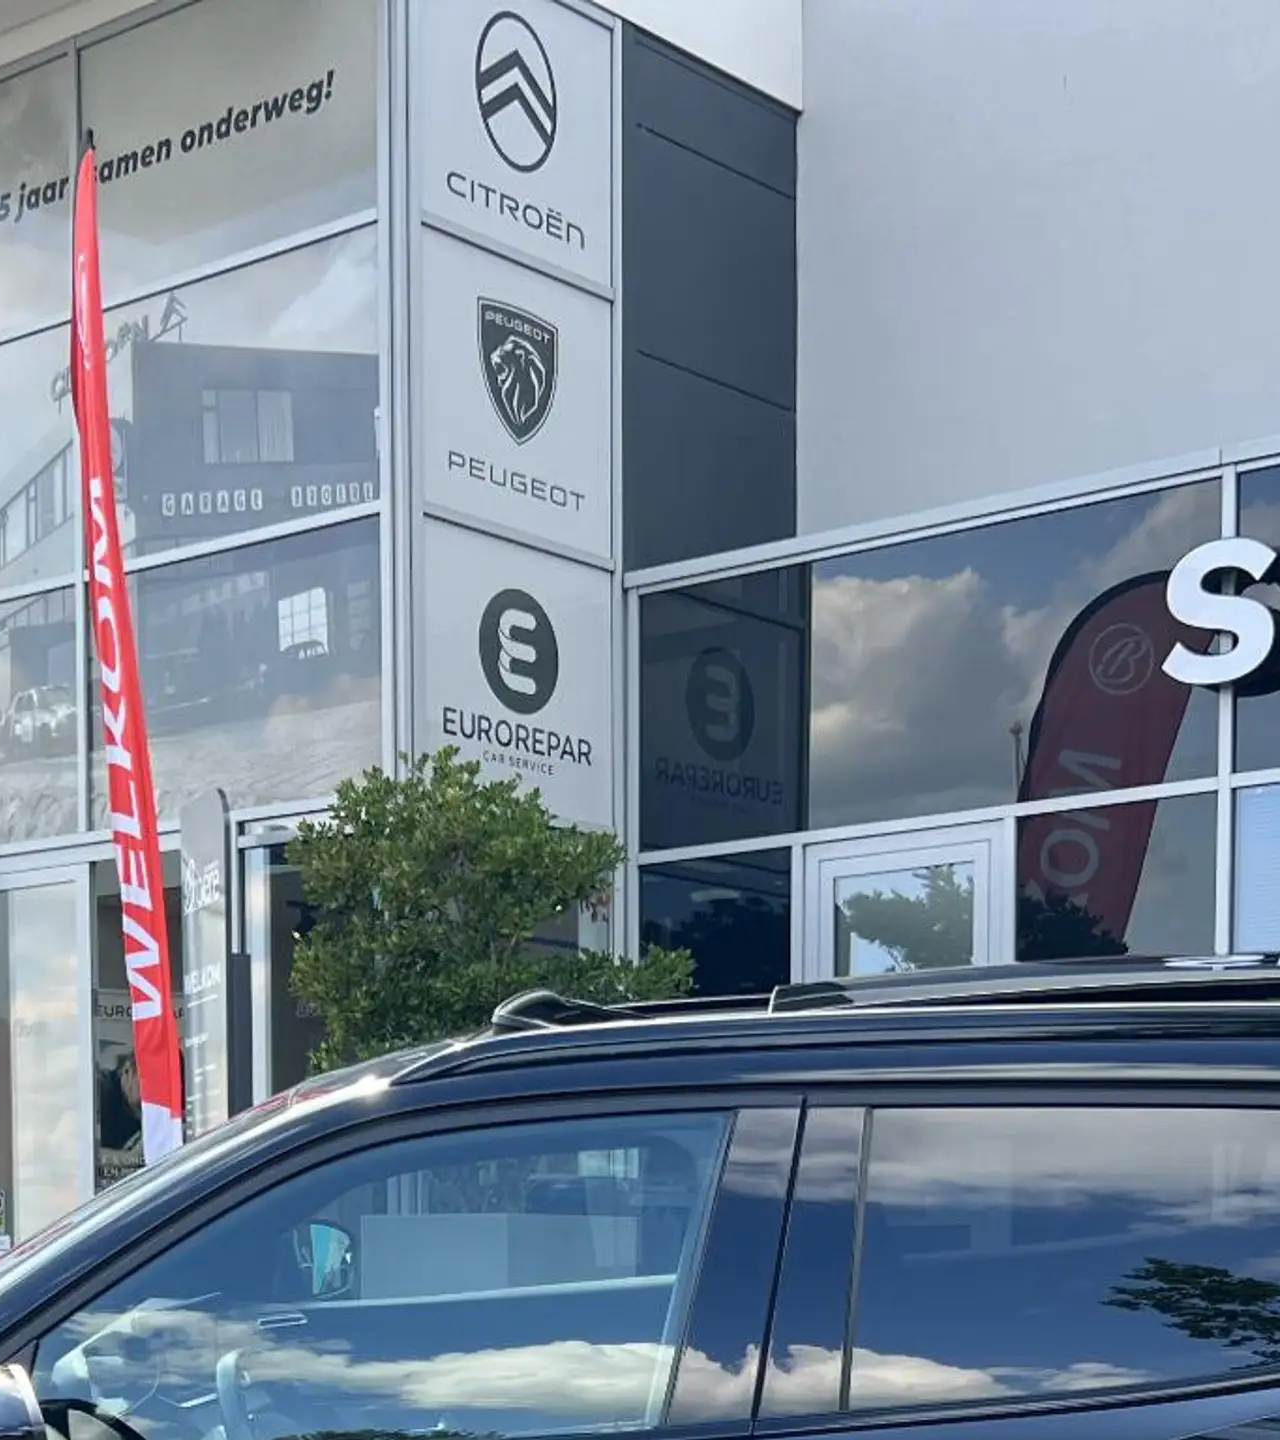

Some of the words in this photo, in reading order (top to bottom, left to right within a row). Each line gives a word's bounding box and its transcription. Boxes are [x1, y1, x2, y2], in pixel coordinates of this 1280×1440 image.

[14, 176, 70, 224] jaar
[180, 69, 335, 153] onderweg!
[446, 170, 586, 251] CITROËN
[484, 310, 551, 345] PEUGEOT
[448, 450, 586, 512] PEUGEOT
[442, 707, 593, 767] EUROREPAR
[509, 754, 555, 776] SERVICE
